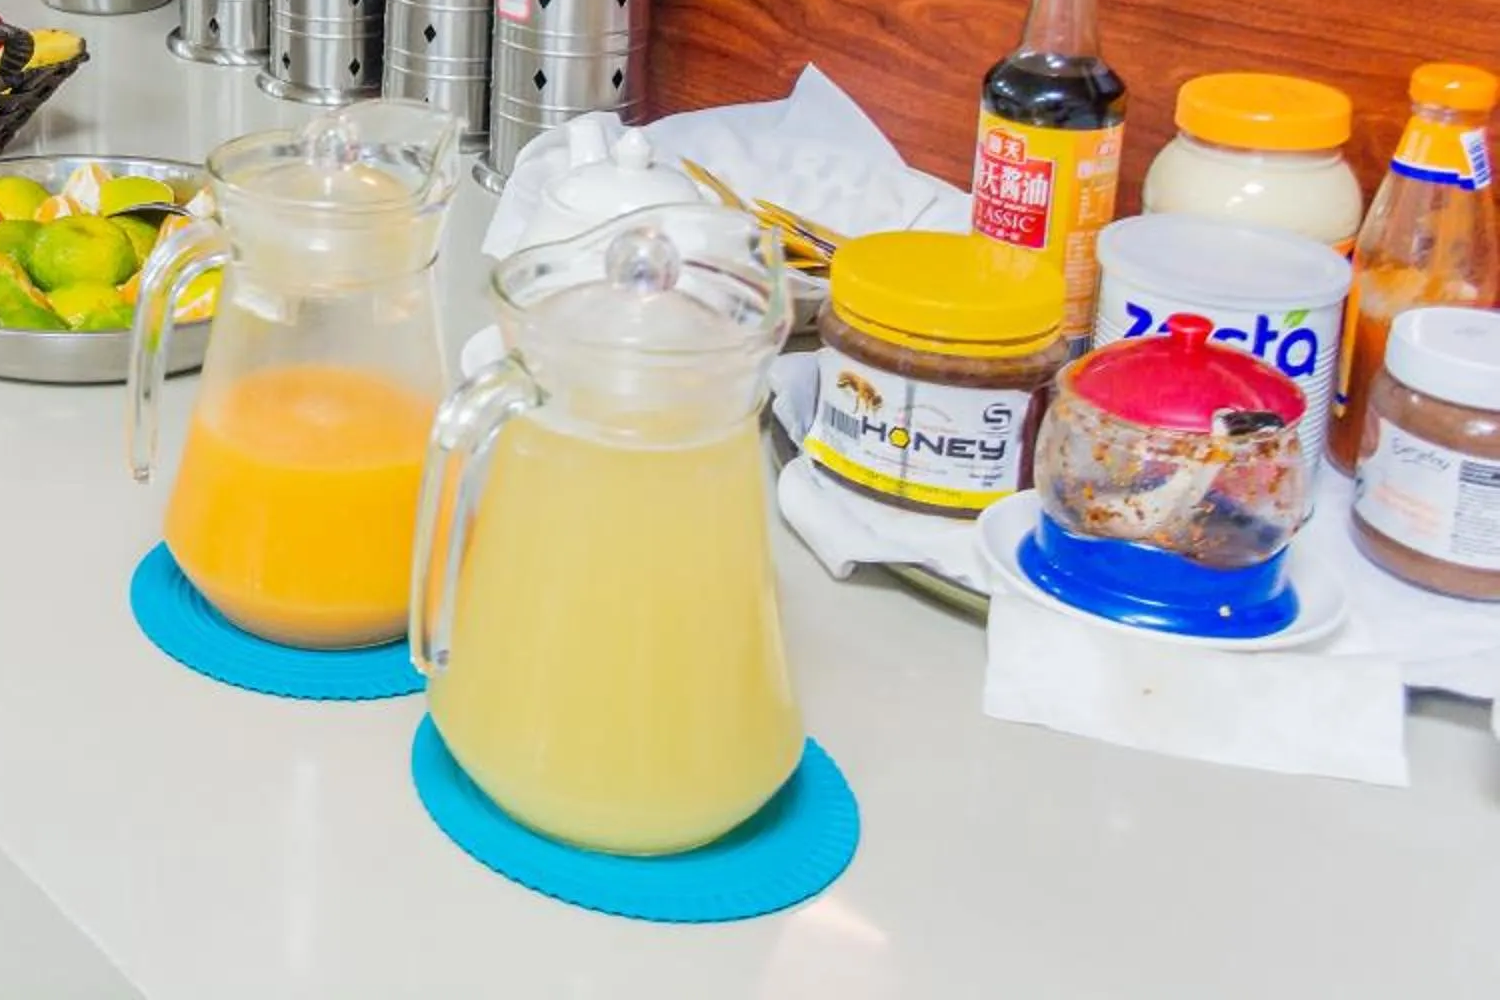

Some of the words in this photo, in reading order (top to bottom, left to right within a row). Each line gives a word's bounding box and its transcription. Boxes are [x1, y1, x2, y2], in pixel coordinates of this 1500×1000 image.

[987, 133, 1020, 158] 天
[979, 158, 1049, 207] 天酱油
[976, 201, 1037, 233] LASSIC
[1124, 301, 1318, 378] zta
[862, 415, 1006, 460] HONEY
